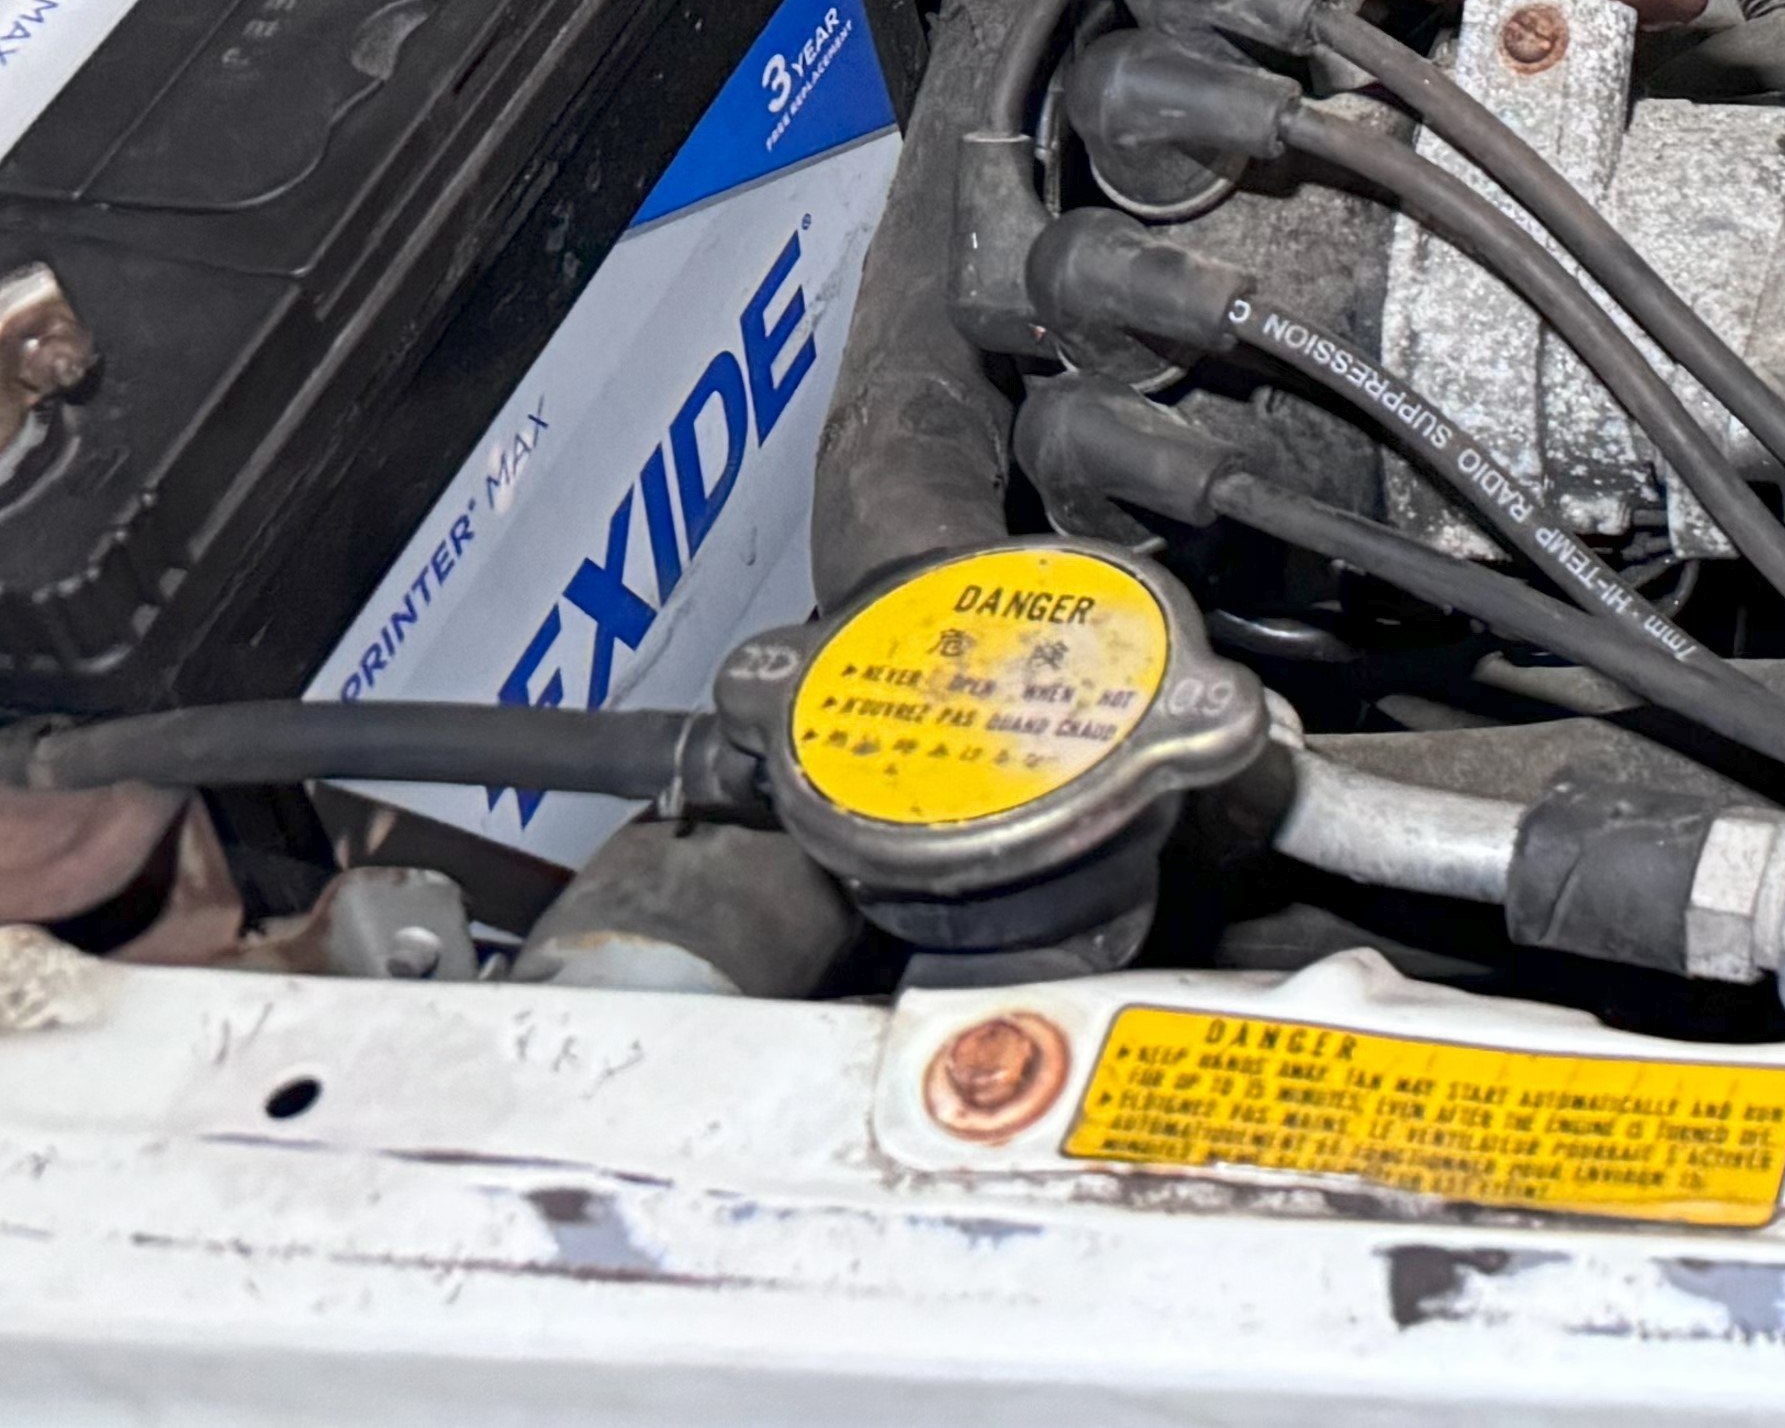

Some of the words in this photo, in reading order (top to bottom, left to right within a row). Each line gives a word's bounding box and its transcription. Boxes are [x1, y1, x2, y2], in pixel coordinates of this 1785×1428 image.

[762, 53, 792, 113] 3
[791, 7, 840, 78] YEAR
[1262, 313, 1453, 450] SUPPRESSION
[486, 394, 550, 511] MAX
[1457, 448, 1534, 523] RADIO
[954, 585, 1096, 625] DANGER
[1643, 614, 1698, 662] 7mm
[862, 664, 923, 687] NEVER
[948, 673, 998, 699] OPEN
[1022, 682, 1076, 704] WHEN
[1097, 689, 1138, 709] HOT
[936, 706, 978, 728] PAS
[985, 712, 1051, 735] QUAND
[1054, 717, 1120, 742] CHAUD
[1205, 1018, 1358, 1061] DANGER
